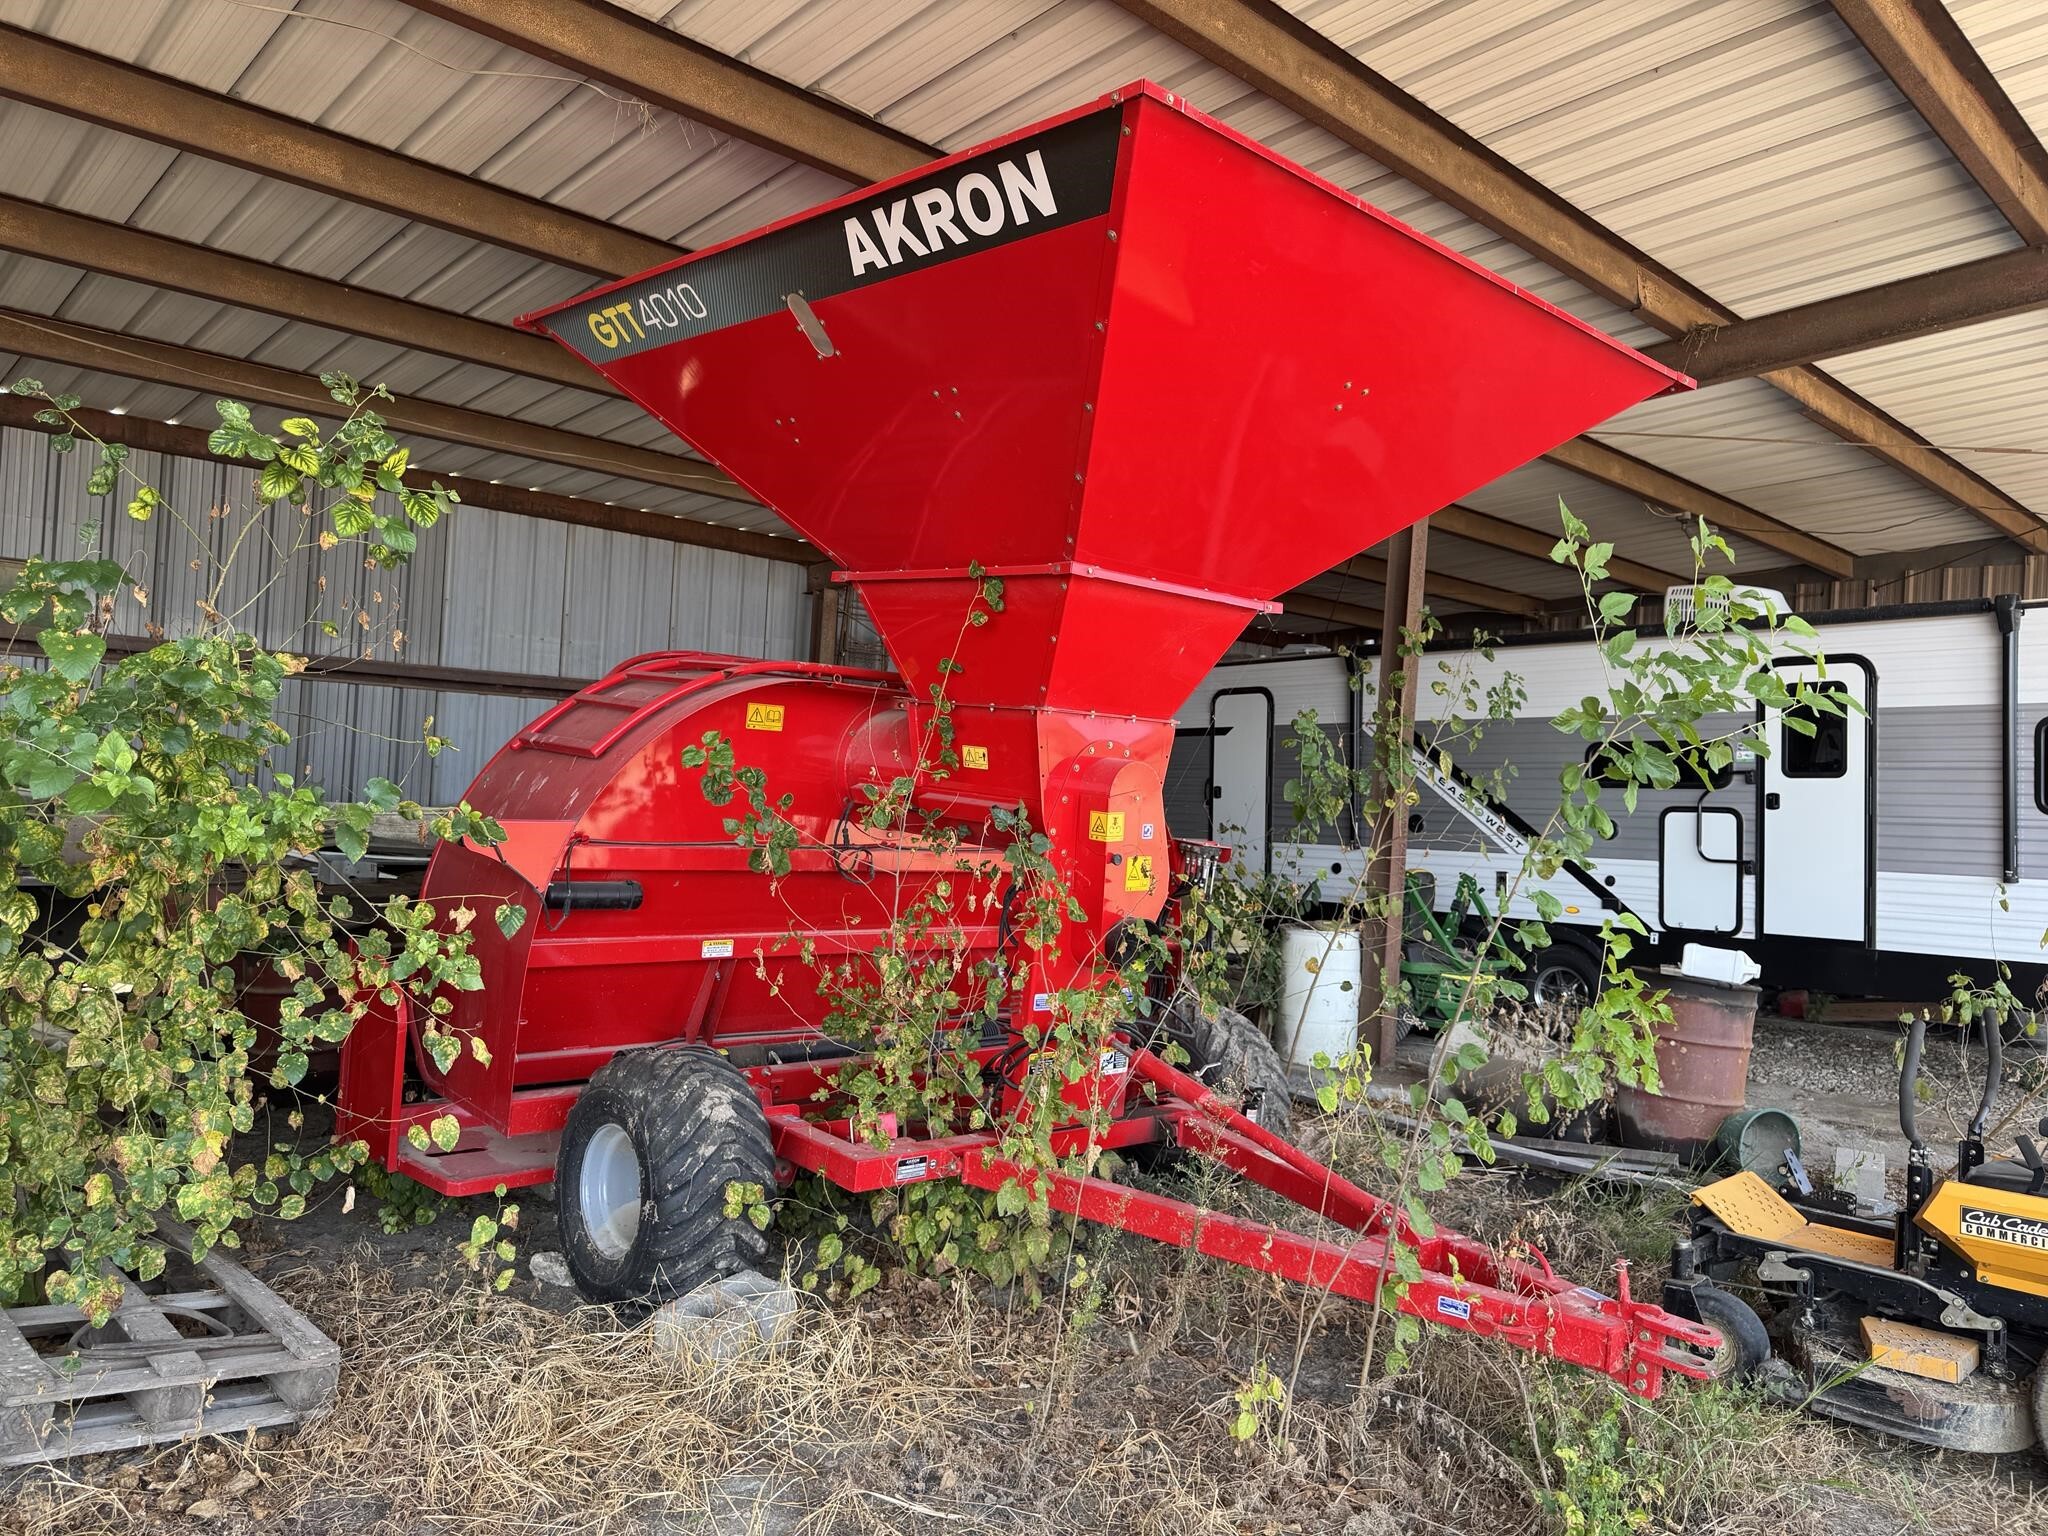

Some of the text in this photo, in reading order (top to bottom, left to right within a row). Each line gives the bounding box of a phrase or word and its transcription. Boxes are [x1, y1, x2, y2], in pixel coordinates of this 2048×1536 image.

[844, 150, 1058, 276] AKRON
[588, 283, 707, 348] GTT 4010
[1438, 776, 1524, 849] EAS WEST
[1965, 1211, 2001, 1227] Cub
[1966, 1224, 2045, 1247] COMMERCI
